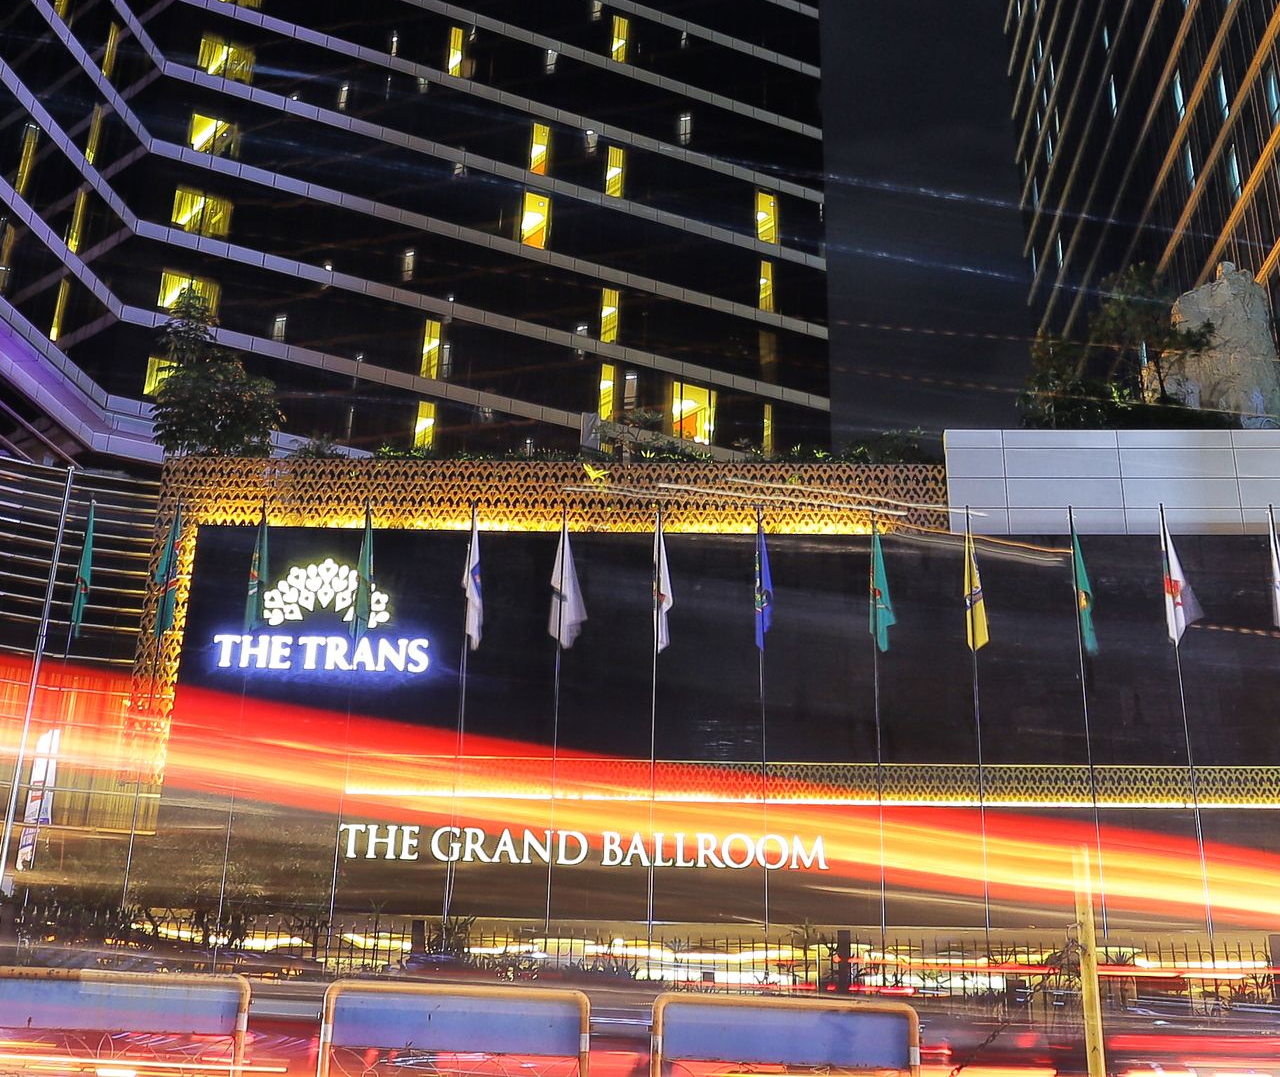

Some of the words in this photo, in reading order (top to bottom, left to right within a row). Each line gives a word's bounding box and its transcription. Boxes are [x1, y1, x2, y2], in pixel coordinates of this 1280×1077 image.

[213, 634, 293, 669] THE
[298, 636, 429, 673] TRANS
[339, 823, 420, 861] THE
[430, 826, 589, 865] GRAND
[600, 831, 830, 870] BALLROOM
